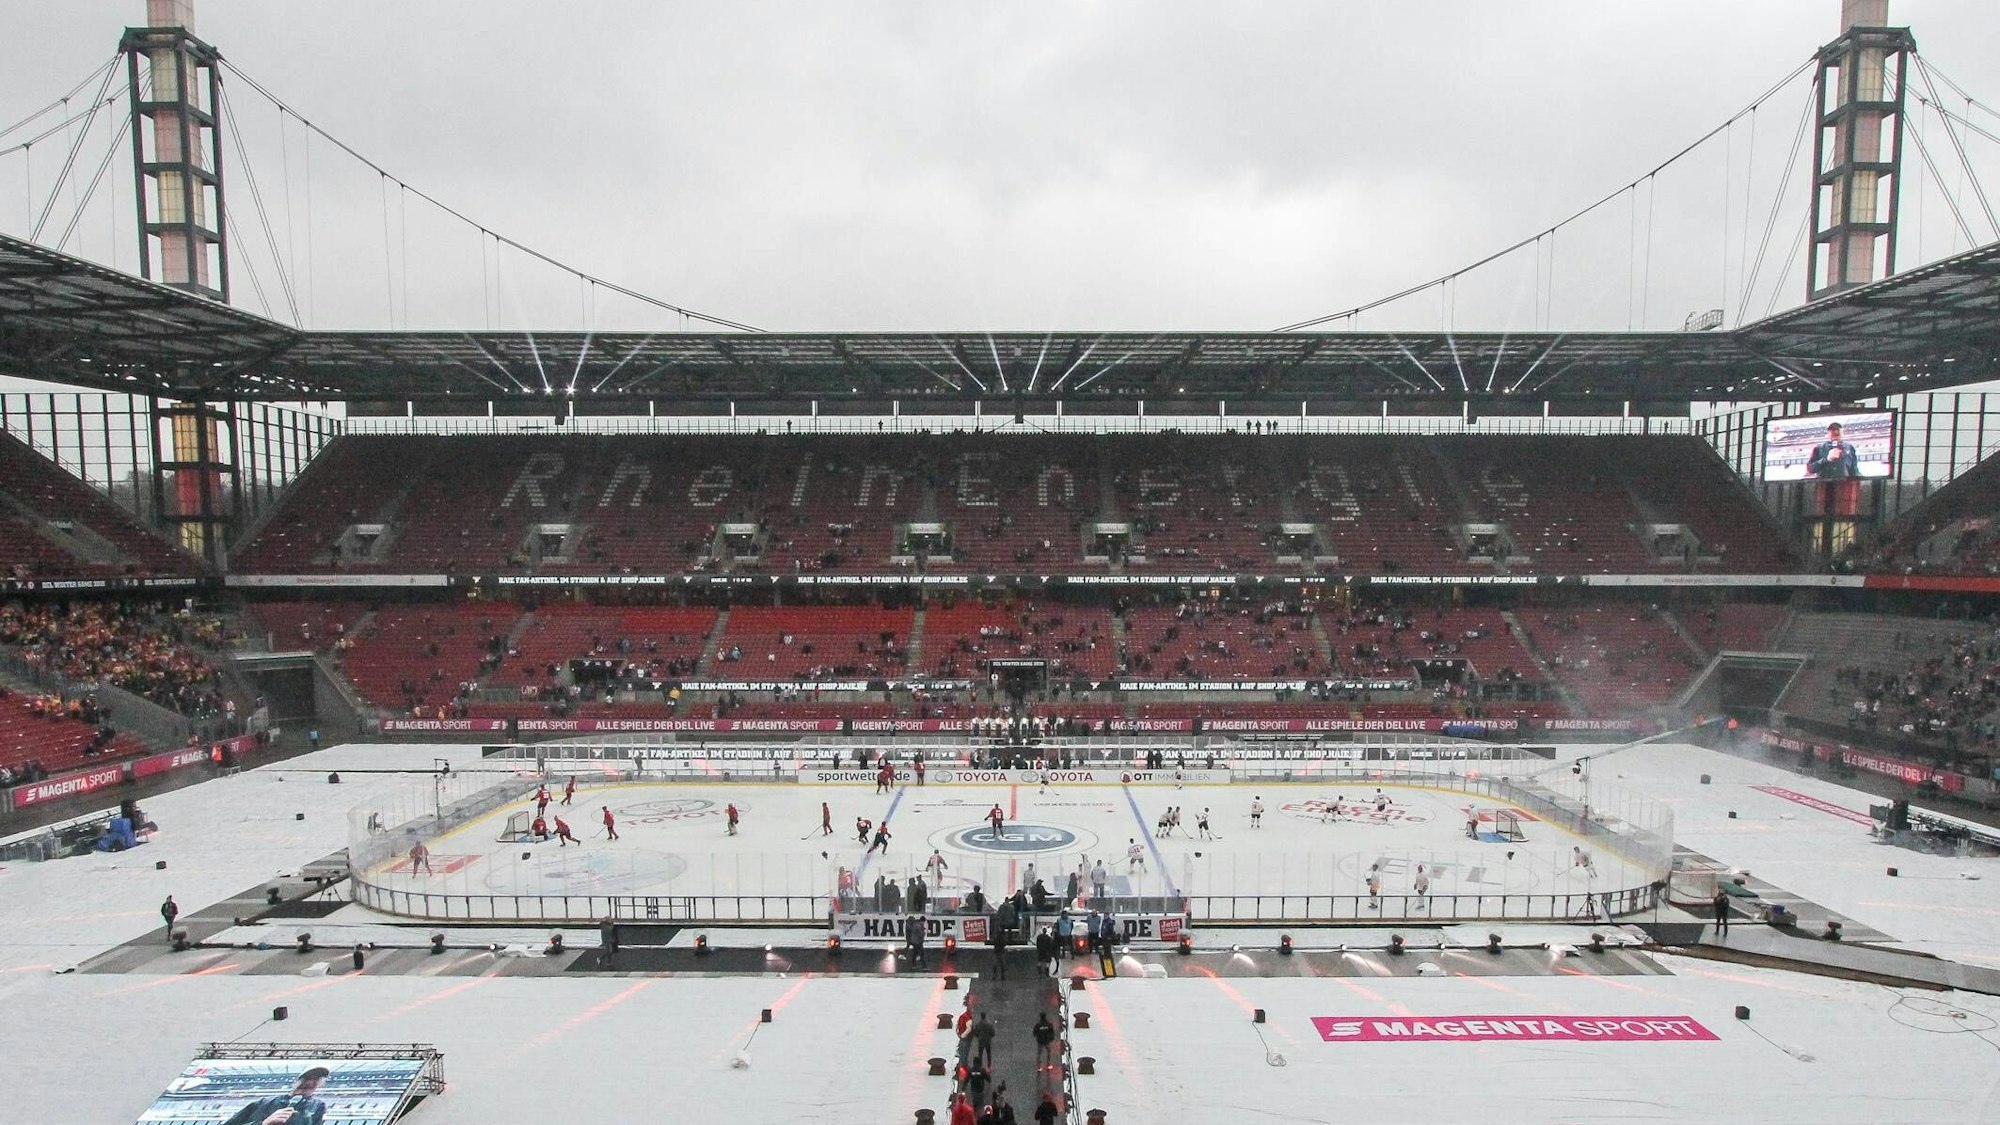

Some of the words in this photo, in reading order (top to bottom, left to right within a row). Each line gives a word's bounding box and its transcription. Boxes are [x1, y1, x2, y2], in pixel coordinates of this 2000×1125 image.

[395, 721, 441, 730] MAGENTA
[442, 721, 471, 730] SPORT
[502, 721, 548, 730] MGENTA
[549, 721, 577, 730] SPORT
[595, 721, 619, 730] ALLE
[620, 720, 653, 730] SPIELE
[654, 720, 675, 730] DER
[676, 720, 694, 730] DEL
[695, 720, 715, 730] LIVE
[742, 720, 789, 730] MAGENTA
[790, 720, 819, 730] SPORT
[895, 720, 924, 730] SPORT
[939, 720, 962, 730] ALLE
[1153, 720, 1183, 730] SPORT
[1213, 720, 1259, 730] MAGENTA
[1260, 720, 1289, 730] SPORT
[1306, 720, 1330, 730] ALLE
[1331, 720, 1363, 730] SPIELE
[1364, 720, 1384, 730] DER
[1385, 720, 1404, 730] DEL
[1405, 720, 1425, 730] LIVE
[1554, 720, 1600, 729] MAGENTA
[1601, 720, 1630, 729] SPORT
[650, 750, 709, 758] FAN-ARTIKEL
[724, 750, 763, 758] STADION
[773, 750, 792, 758] AUF
[1234, 750, 1274, 758] STADION
[1283, 750, 1302, 758] AUF
[1303, 750, 1362, 758] SHOP.HAIE.DE
[1857, 756, 1885, 773] SPIELE
[1886, 763, 1904, 777] DER
[1904, 767, 1921, 782] DEL
[817, 770, 910, 783] sportwettde
[956, 772, 1007, 781] TOYOTA
[1049, 772, 1093, 781] OYOTA
[1133, 772, 1153, 781] OTT
[1154, 772, 1211, 781] IMMBILIEN
[39, 778, 88, 799] MAGENTA
[88, 769, 118, 786] SPORT
[621, 809, 722, 826] TOYOT
[972, 833, 1063, 842] CGM
[864, 919, 956, 937] HAIDE
[1371, 1020, 1575, 1037] MAGENTA
[1572, 1020, 1696, 1036] SPORT
